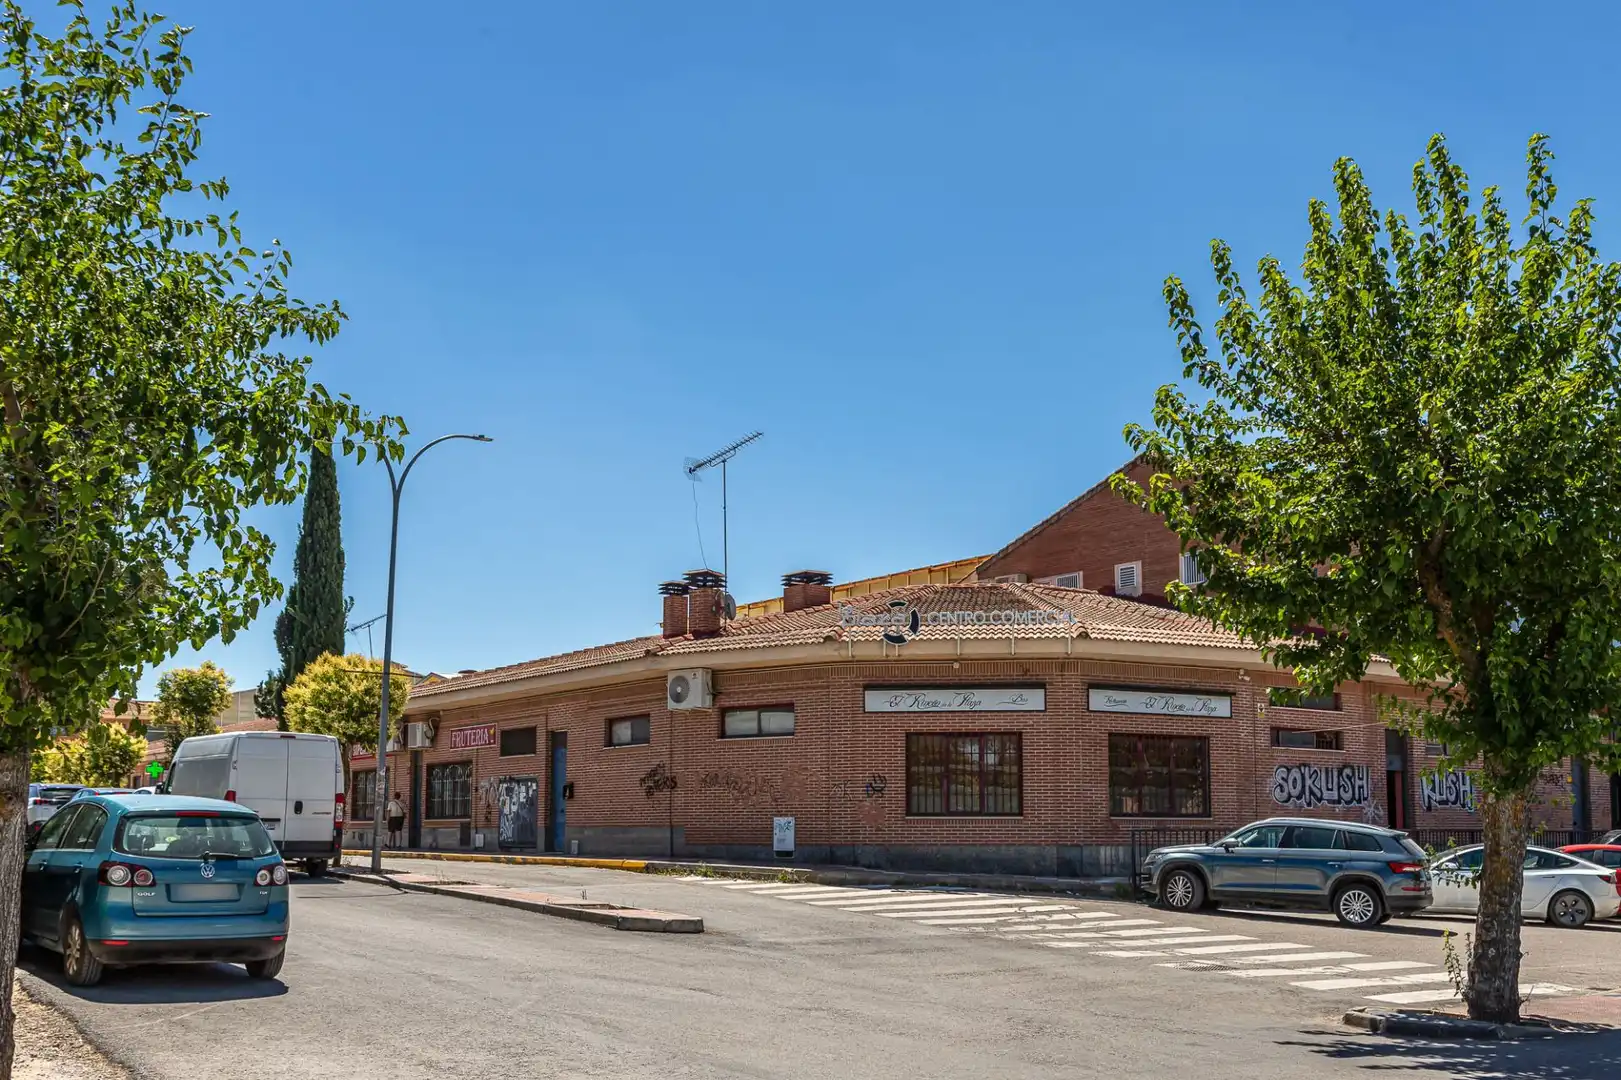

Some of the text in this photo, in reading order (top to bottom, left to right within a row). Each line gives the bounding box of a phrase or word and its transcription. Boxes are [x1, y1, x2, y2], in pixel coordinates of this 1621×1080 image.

[927, 611, 986, 625] CENTRO
[883, 695, 904, 708] El
[953, 691, 983, 710] Plaza
[451, 728, 489, 748] FRUTERIA
